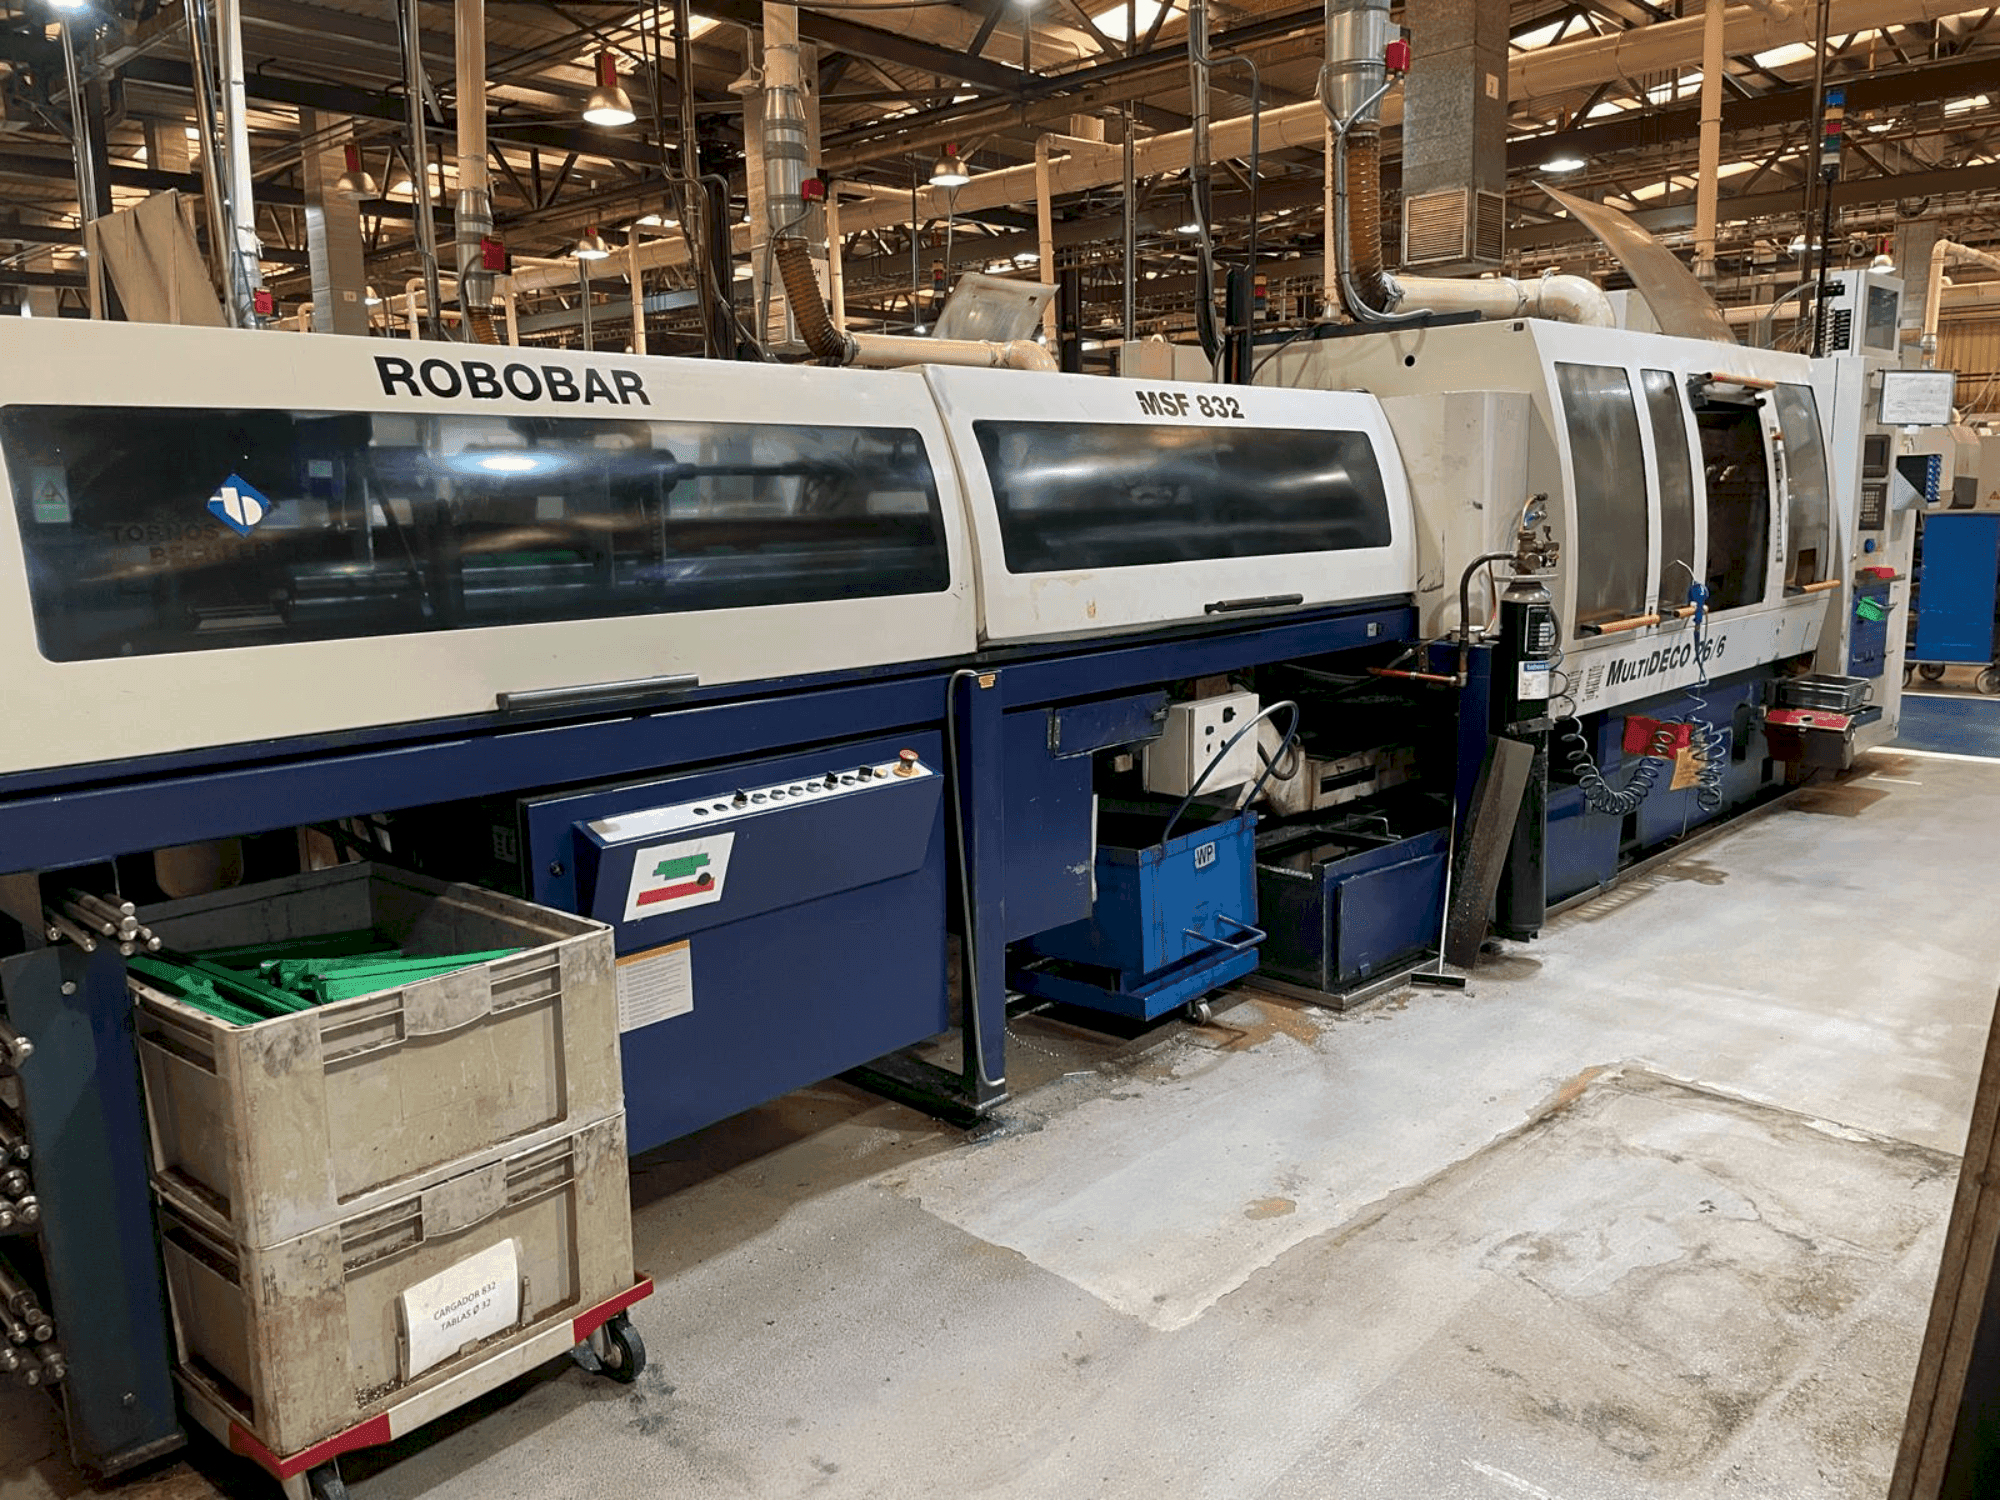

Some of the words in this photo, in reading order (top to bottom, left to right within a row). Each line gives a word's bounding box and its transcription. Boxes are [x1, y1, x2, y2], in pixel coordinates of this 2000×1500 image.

[374, 355, 651, 406] ROBOBAR
[1135, 390, 1190, 417] MSF
[1196, 394, 1245, 419] 832
[1196, 844, 1214, 866] WP
[433, 1289, 480, 1321] CARGADOR
[481, 1281, 496, 1296] 832
[441, 1309, 471, 1331] TABLAS
[482, 1298, 491, 1310] 32
